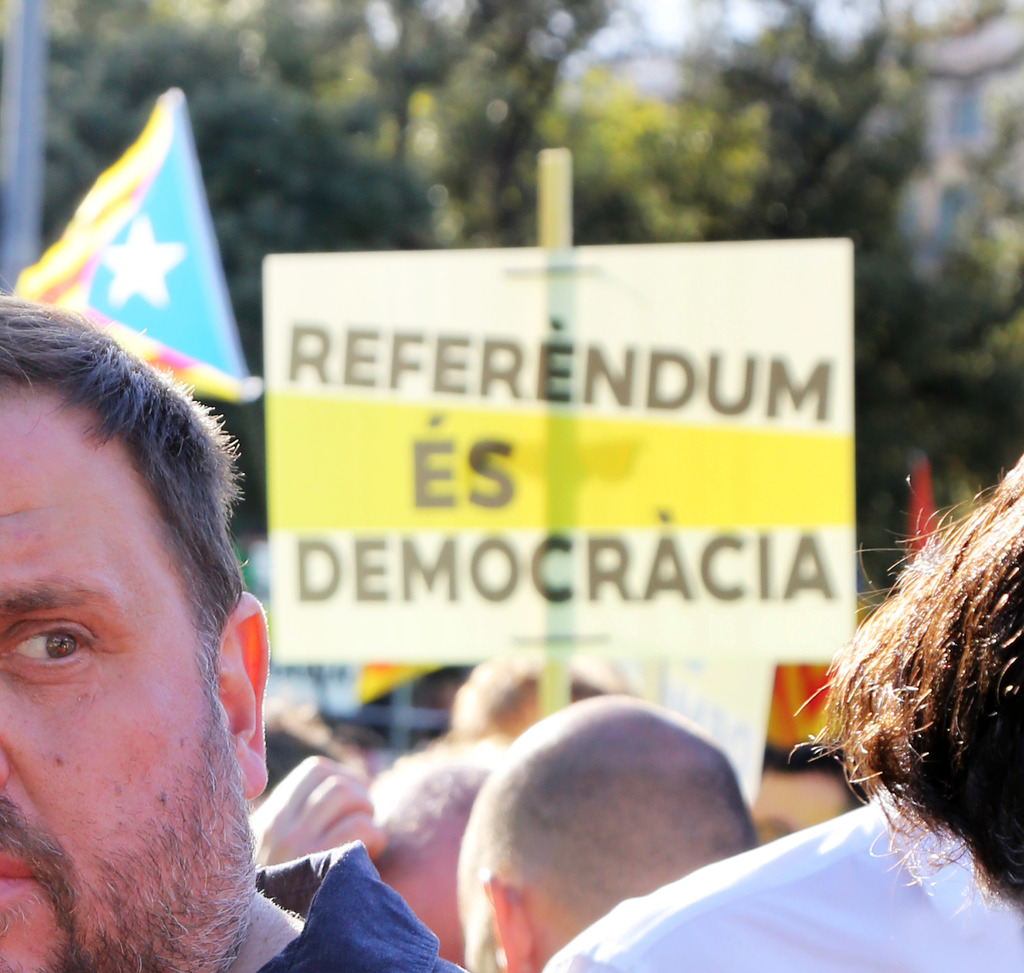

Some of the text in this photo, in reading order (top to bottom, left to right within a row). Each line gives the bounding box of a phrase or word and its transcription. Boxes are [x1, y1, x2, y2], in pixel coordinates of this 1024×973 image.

[288, 316, 834, 423] REFERÈNDUM
[412, 414, 517, 510] ÉS
[297, 511, 837, 603] DEMOCRÀCIA
